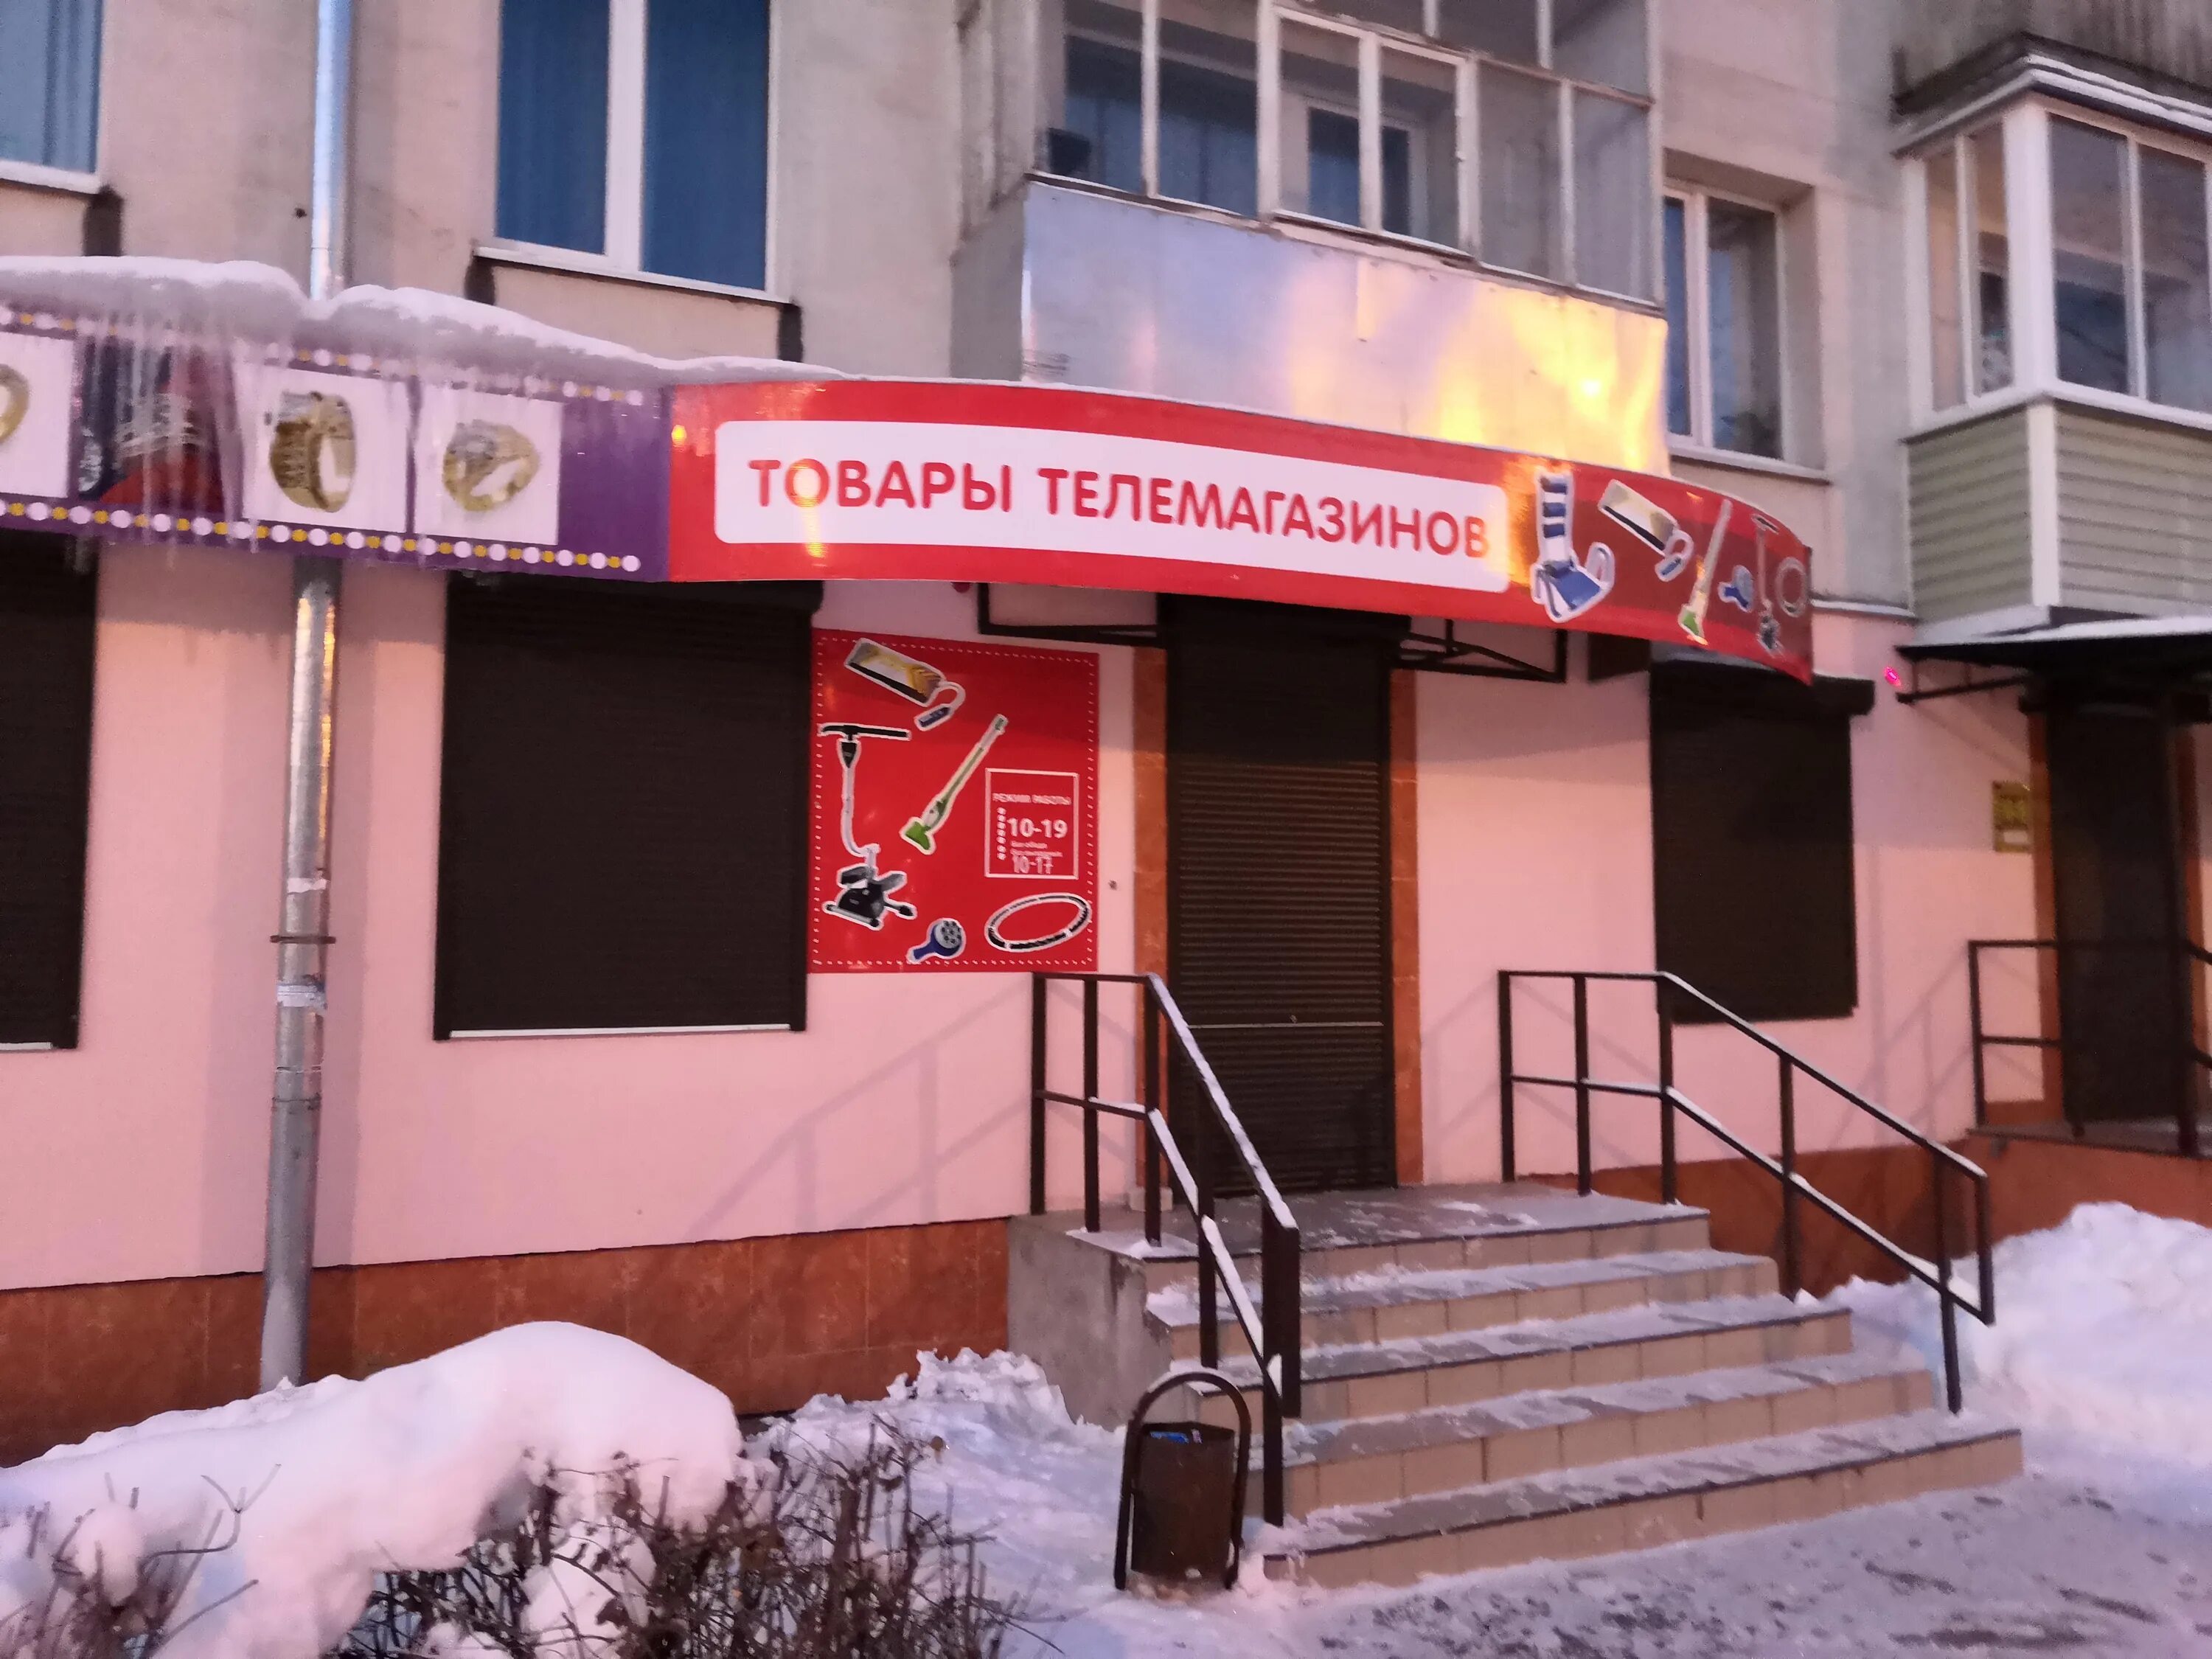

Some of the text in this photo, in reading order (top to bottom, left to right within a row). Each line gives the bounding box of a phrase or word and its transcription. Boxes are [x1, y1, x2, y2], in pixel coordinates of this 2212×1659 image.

[748, 458, 1489, 559] ТОВАРЫ ТЕЛЕМАГАЗИНОВ
[1006, 817, 1068, 838] 10-19
